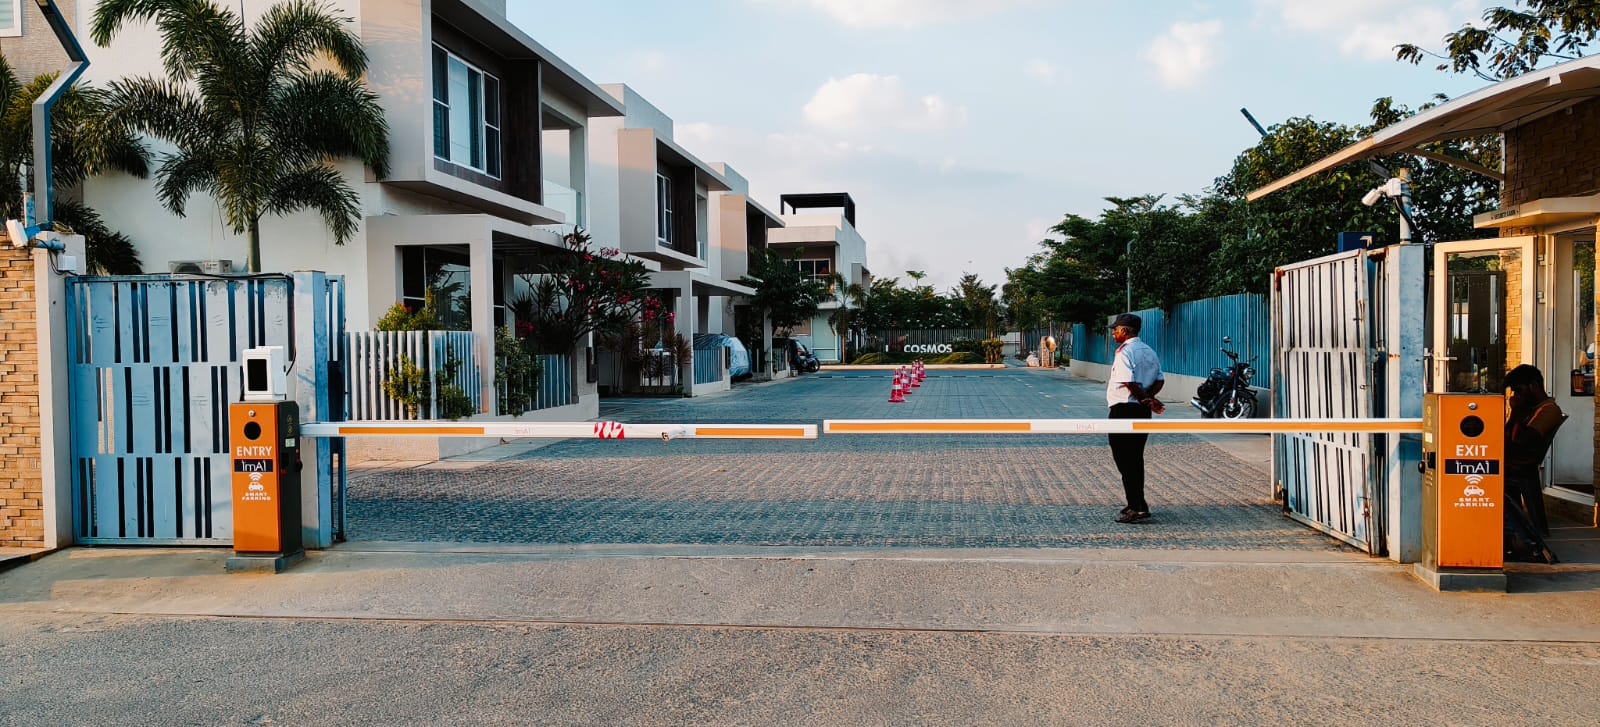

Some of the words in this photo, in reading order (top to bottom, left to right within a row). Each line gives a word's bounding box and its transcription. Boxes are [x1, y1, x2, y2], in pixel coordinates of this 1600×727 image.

[903, 343, 953, 353] COSMOS
[236, 446, 272, 457] ENTRY
[1455, 444, 1488, 457] EXIT
